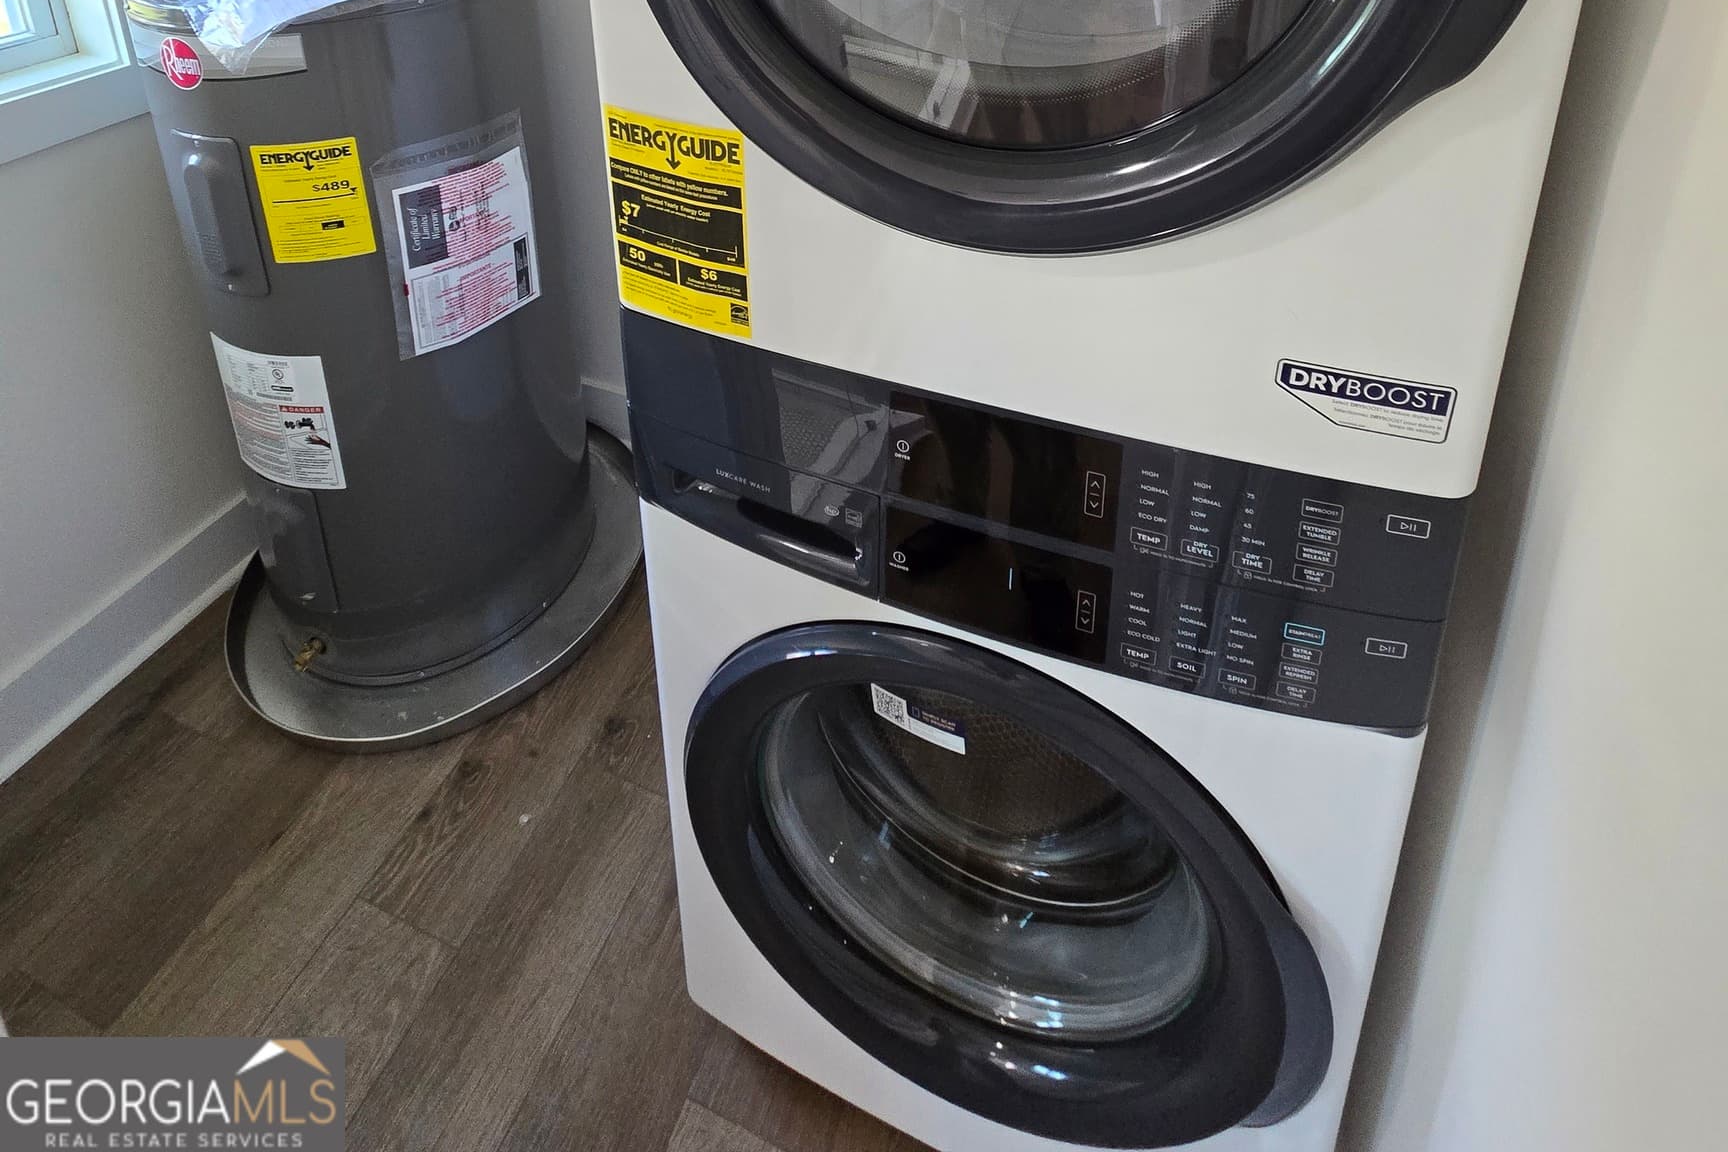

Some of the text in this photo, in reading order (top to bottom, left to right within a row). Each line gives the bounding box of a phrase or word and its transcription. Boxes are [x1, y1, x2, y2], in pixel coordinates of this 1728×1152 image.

[160, 37, 201, 81] Rheem
[608, 117, 741, 167] ENERGYGUIDE
[259, 146, 352, 166] ENERGYGUIDE
[621, 200, 641, 218] $7
[629, 248, 646, 262] 50
[700, 268, 718, 281] $6
[1288, 367, 1445, 411] DRYBOOST
[1141, 469, 1160, 479] HIGH
[1140, 483, 1170, 496] NORMAL
[1193, 480, 1212, 490] HIGH
[1139, 498, 1155, 507] LOW
[1192, 496, 1222, 508] NORMAL
[1138, 512, 1167, 524] ECO DRY
[1190, 510, 1207, 519] LOW
[1189, 524, 1210, 534] DAMP
[1302, 524, 1338, 536] EXTENDED
[1137, 532, 1161, 544] TEMP
[1306, 531, 1332, 541] TUMBLE
[1193, 540, 1208, 549] DRY
[1251, 539, 1265, 547] MIN
[1186, 545, 1214, 558] LEVEL
[1245, 552, 1261, 561] DRY
[1241, 557, 1263, 569] TIME
[1303, 568, 1325, 577] DELAY
[1305, 575, 1321, 583] TIME
[1130, 591, 1144, 599] HOT
[1129, 604, 1150, 614] WARM
[1180, 603, 1202, 613] HEAVY
[1128, 617, 1147, 627] COOL
[1178, 616, 1207, 628] NORMAL
[1231, 615, 1247, 624] MAX
[1127, 630, 1160, 643] ECO COLD
[1177, 629, 1197, 639] LIGHT
[1229, 628, 1257, 639] MEDIUM
[1176, 642, 1217, 657] EXTRA LIGHT
[1227, 642, 1244, 650] LOW
[1292, 647, 1313, 656] EXTRA
[1126, 648, 1150, 659] TEMP
[1226, 654, 1254, 666] NO SPIN
[1176, 661, 1197, 672] SOIL
[1226, 674, 1248, 685] SPIN
[1286, 686, 1307, 694] DELAY
